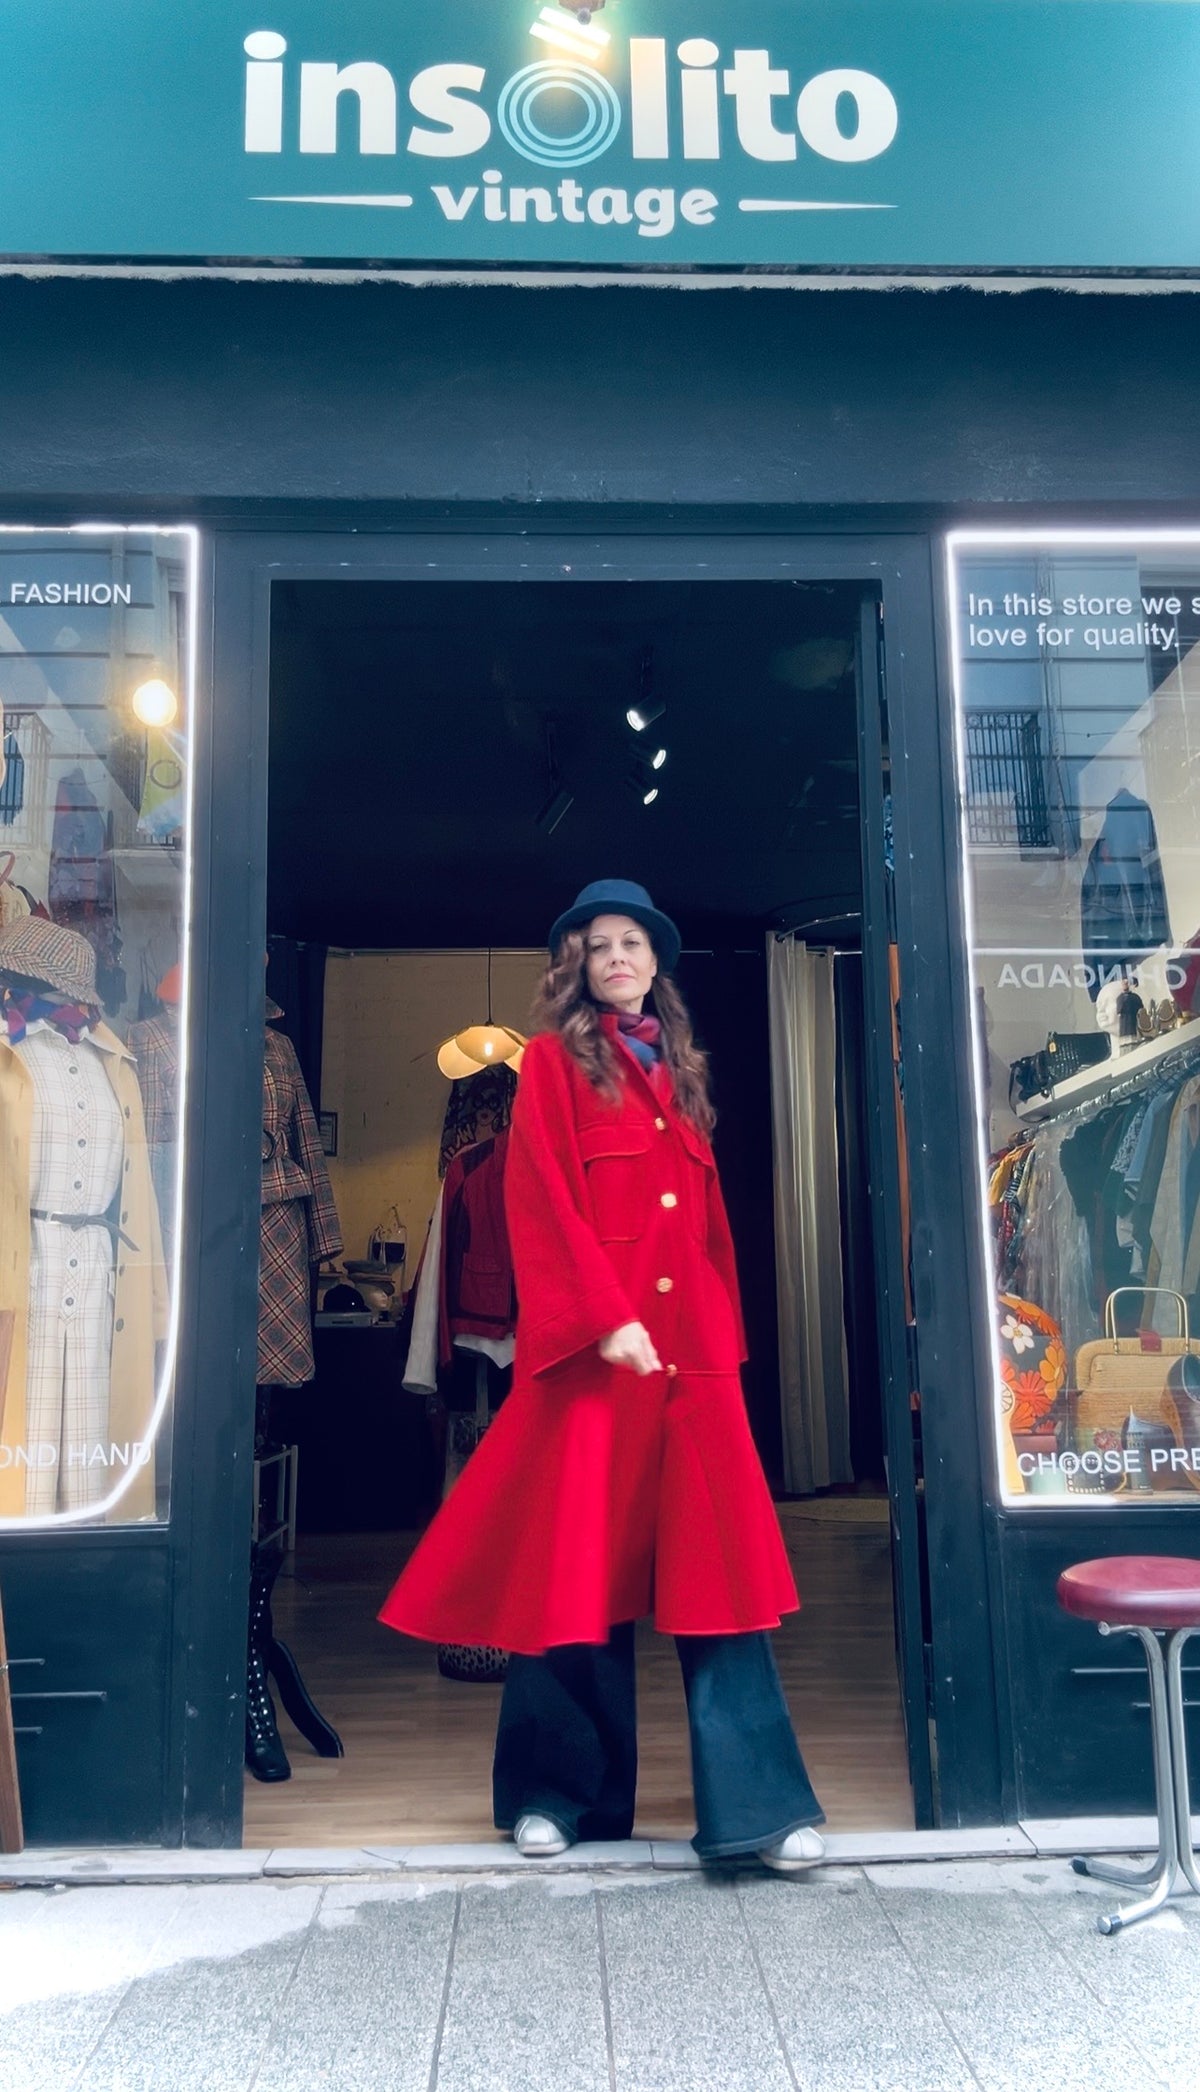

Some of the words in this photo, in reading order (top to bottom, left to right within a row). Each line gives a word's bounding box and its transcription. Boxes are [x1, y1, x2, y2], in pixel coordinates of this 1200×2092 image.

[430, 169, 719, 237] vintage
[10, 583, 131, 604] FASHION
[969, 593, 994, 616] In
[1003, 593, 1053, 616] this
[1062, 594, 1133, 616] store
[1142, 597, 1182, 615] we
[969, 624, 1027, 646] love
[1036, 623, 1075, 646] for
[68, 1442, 152, 1467] HAND
[1017, 1450, 1142, 1476] CHOOSE
